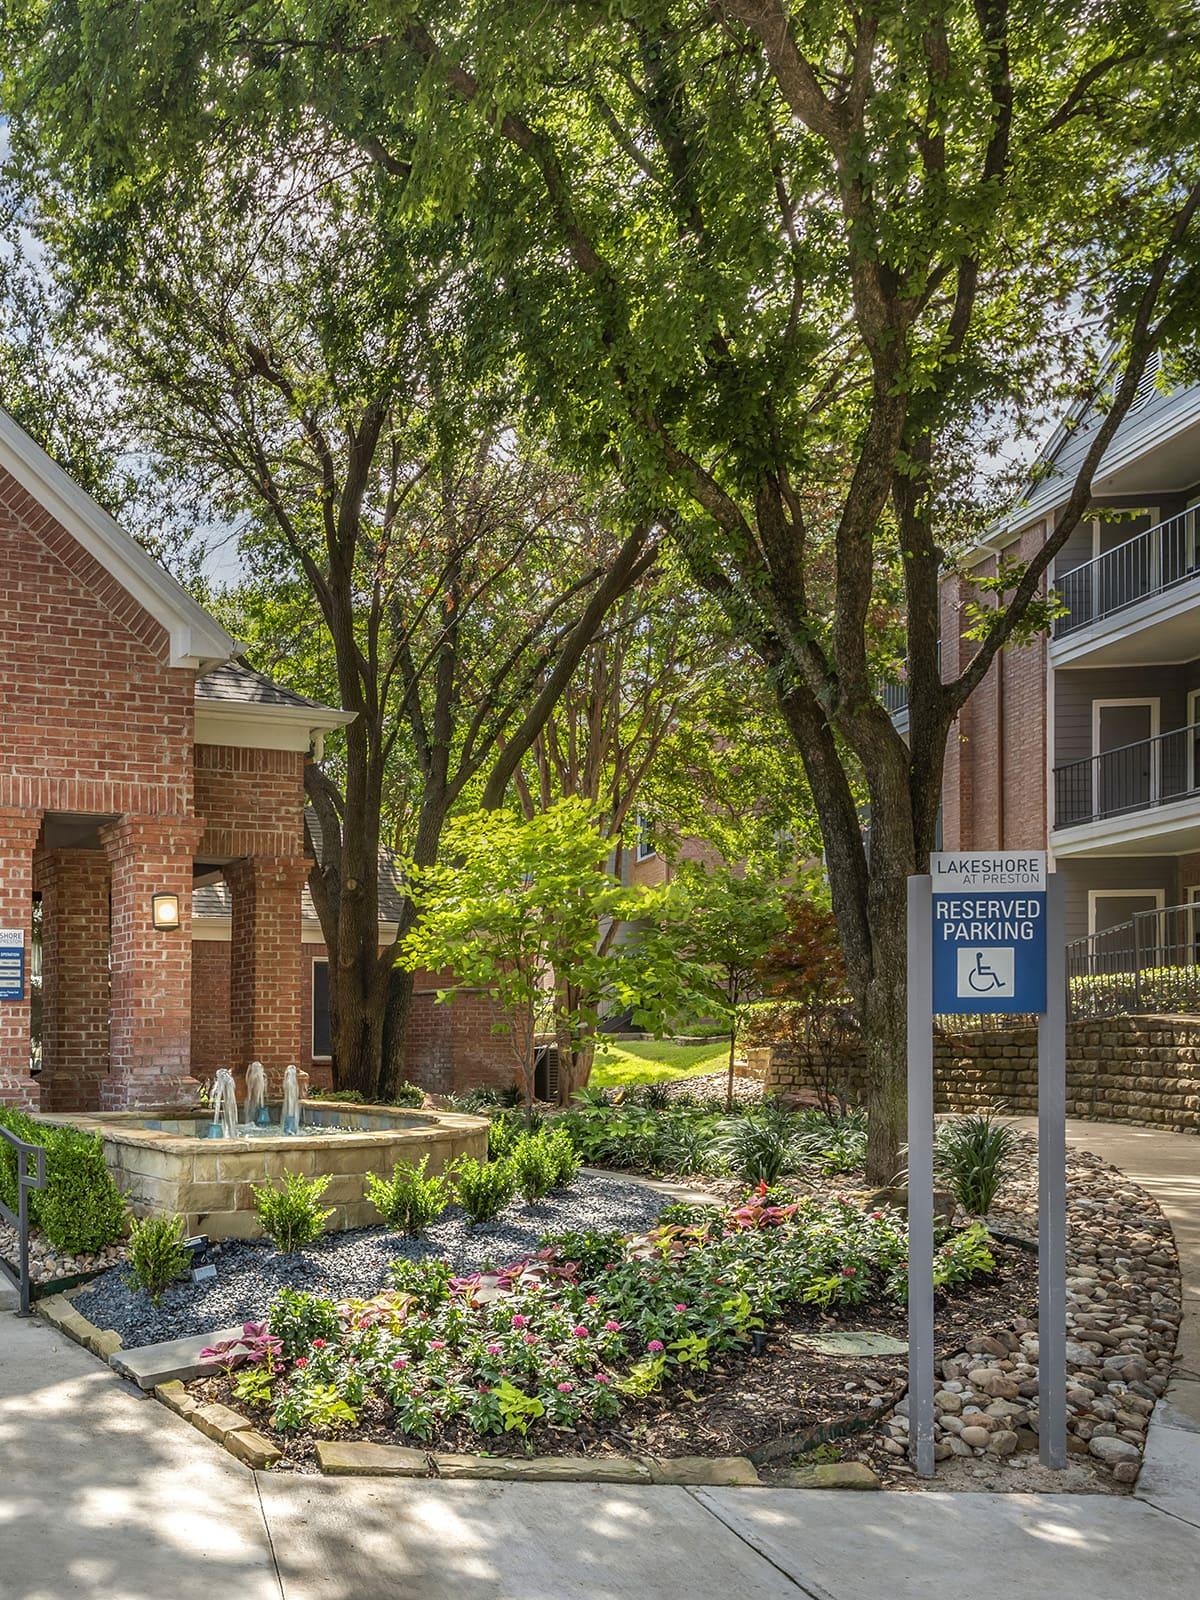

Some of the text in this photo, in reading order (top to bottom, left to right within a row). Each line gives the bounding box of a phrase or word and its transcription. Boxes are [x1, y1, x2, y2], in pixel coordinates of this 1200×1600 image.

[938, 858, 1039, 874] LAKESHORE
[962, 873, 1040, 884] AT PRESTON
[936, 900, 1040, 919] RESERVED
[943, 921, 1034, 941] PARKING
